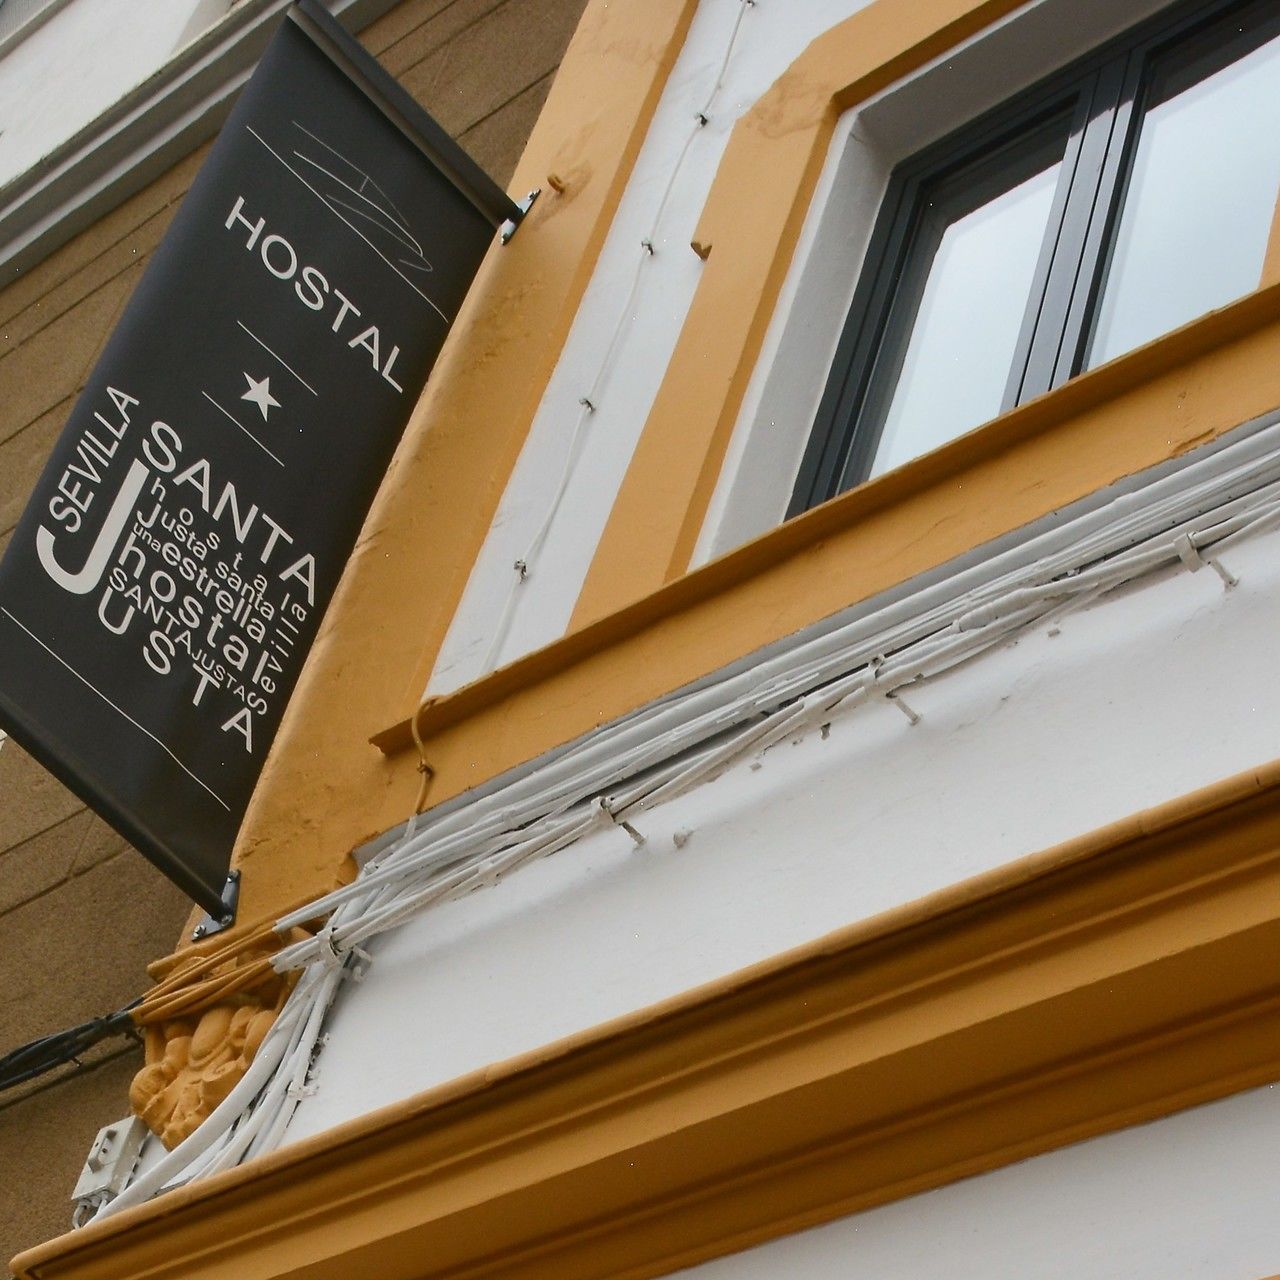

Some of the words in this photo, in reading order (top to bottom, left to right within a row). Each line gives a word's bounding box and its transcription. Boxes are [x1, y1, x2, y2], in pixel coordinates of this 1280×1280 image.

[225, 196, 403, 394] HOSTAL
[49, 386, 140, 533] SEVILLA
[142, 421, 315, 606] SANTA
[118, 532, 269, 685] hostal
[215, 561, 275, 621] santa
